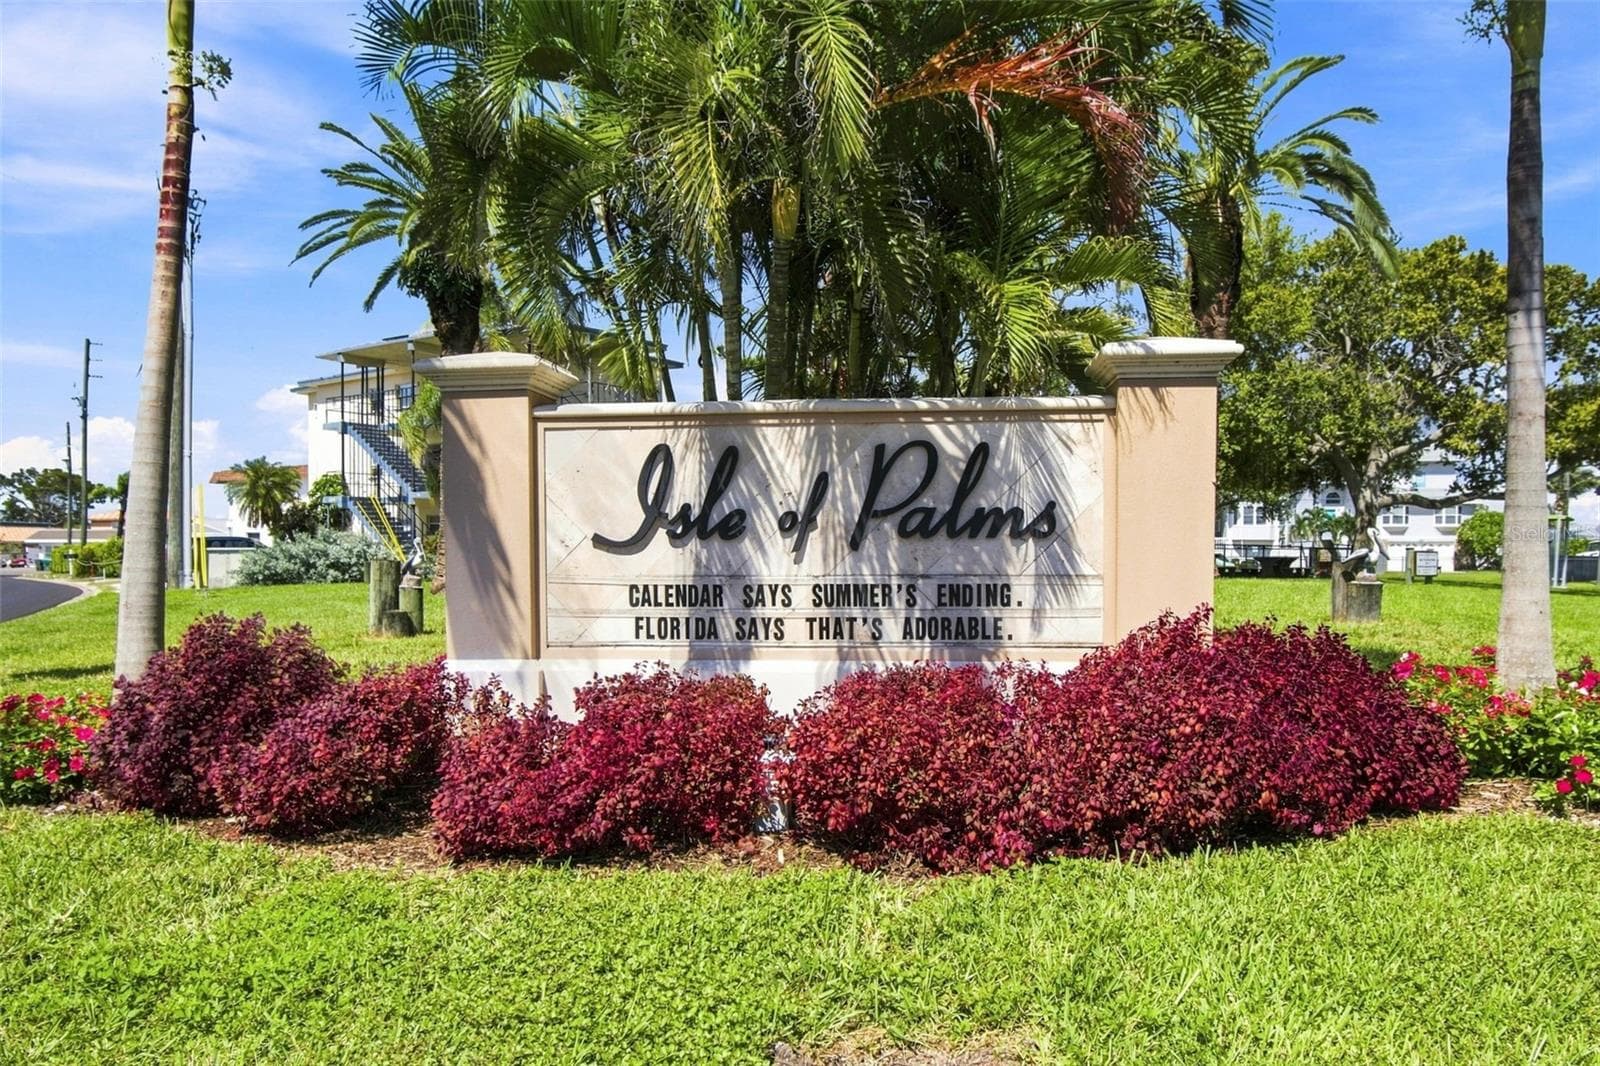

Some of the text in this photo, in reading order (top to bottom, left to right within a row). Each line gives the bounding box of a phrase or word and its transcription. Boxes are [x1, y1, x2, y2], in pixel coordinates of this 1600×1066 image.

[591, 439, 1057, 553] Isle of Palms
[629, 583, 1023, 609] CALENDAR SAYS SUMMER'S ENDING.
[635, 616, 1013, 641] FLORIDA SAYS THAT'S ADORABLE.
